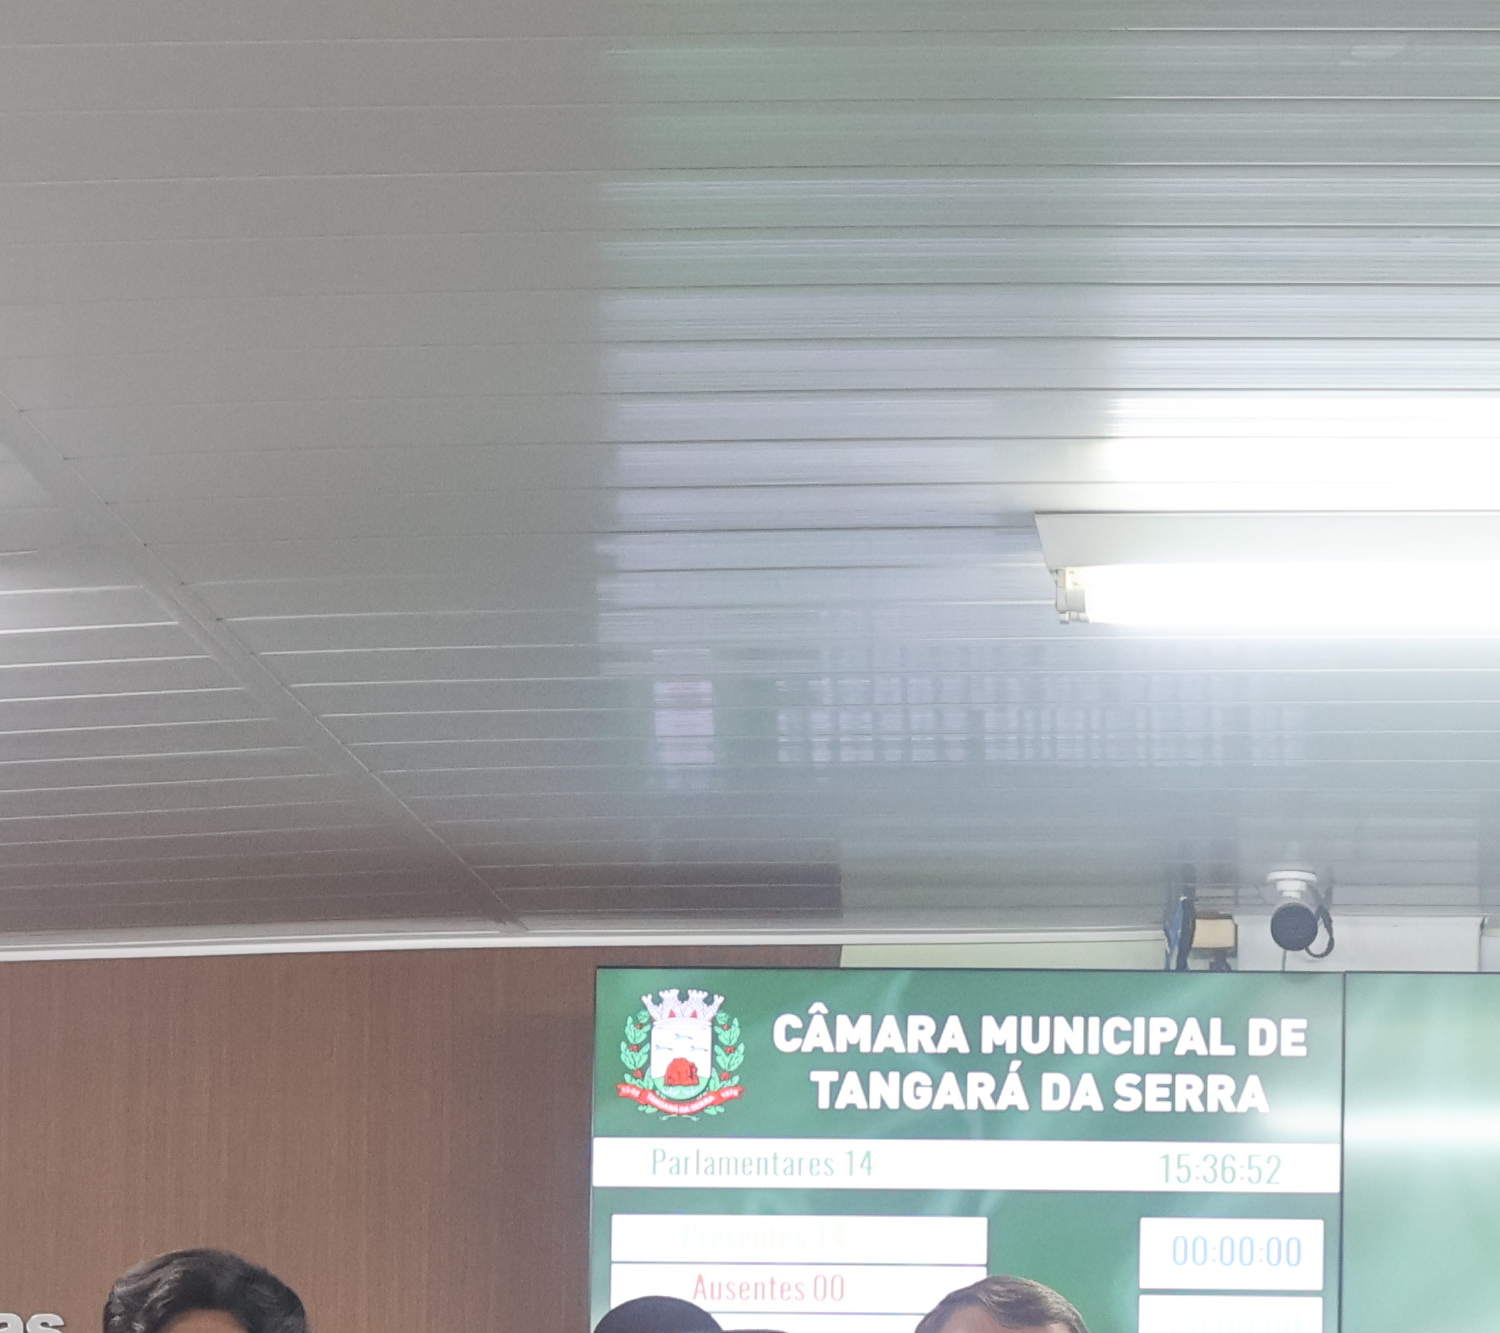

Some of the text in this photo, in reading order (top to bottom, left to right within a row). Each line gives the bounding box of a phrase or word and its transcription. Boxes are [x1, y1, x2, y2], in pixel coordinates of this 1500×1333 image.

[773, 1001, 1308, 1057] CÂMARA MUNICIPAL DE
[810, 1060, 1269, 1113] TANGARÁ DA SERRA
[652, 1148, 875, 1177] Parlamentares 14
[1160, 1153, 1282, 1185] 15:36:52
[1172, 1236, 1301, 1267] 00:00:00
[692, 1274, 845, 1301] Ausentes 00
